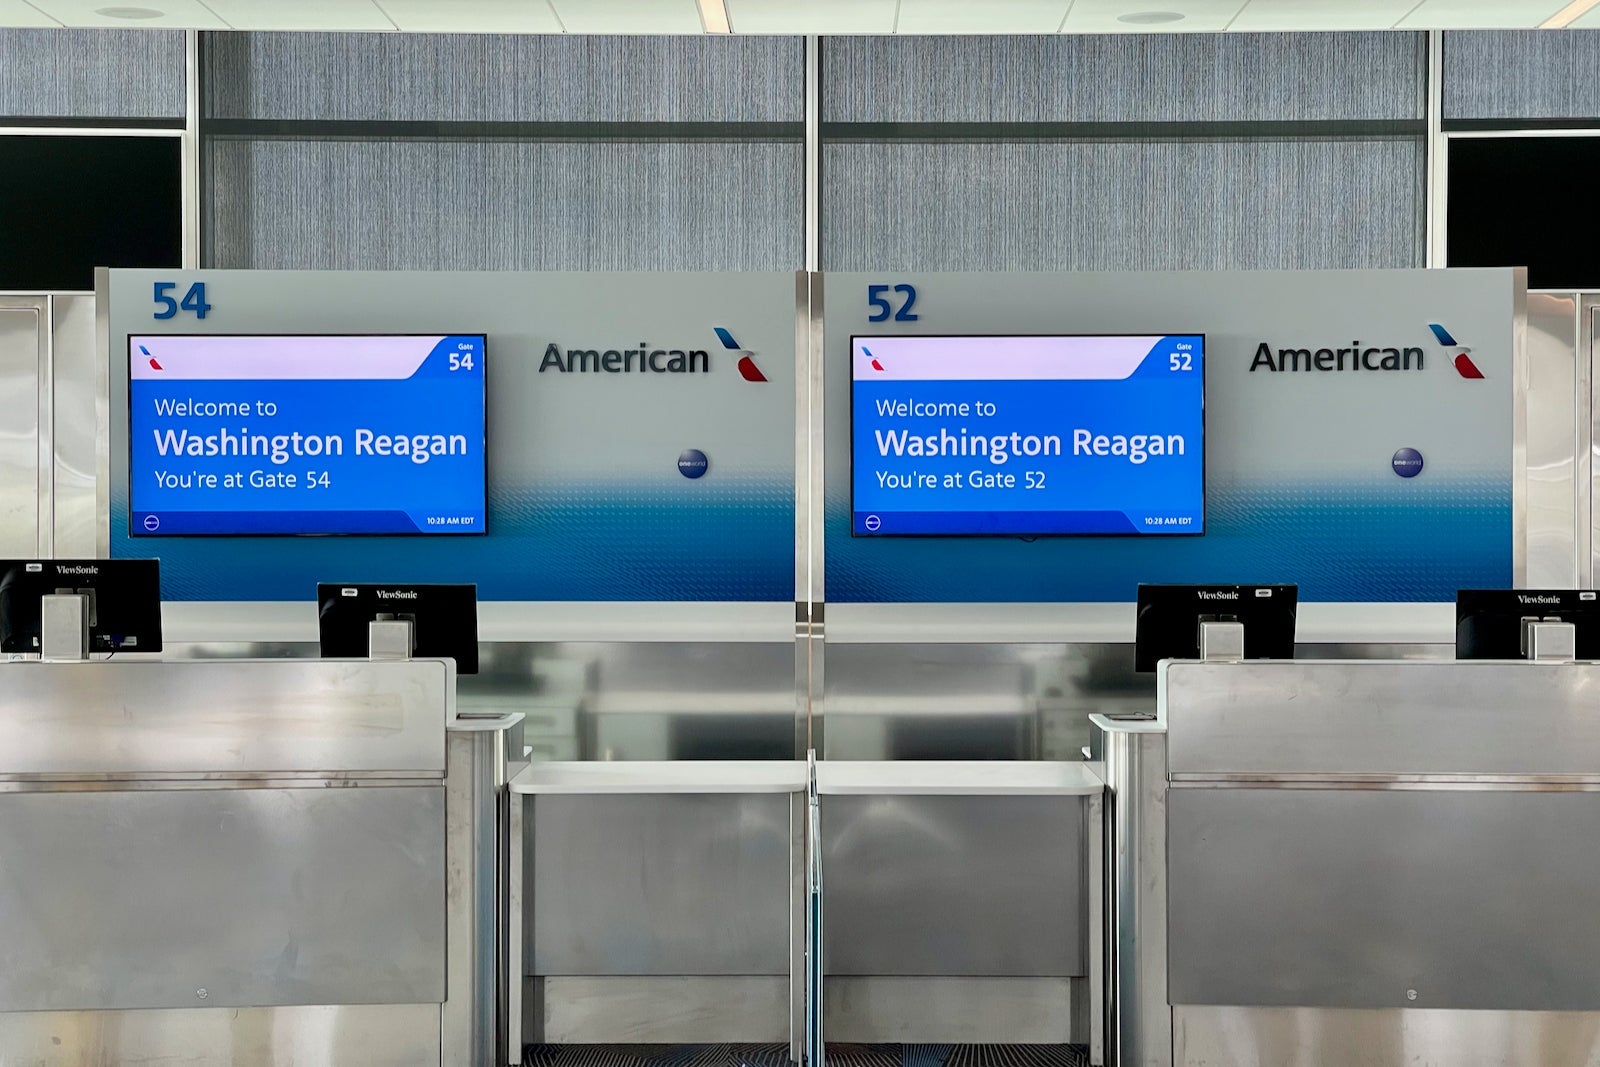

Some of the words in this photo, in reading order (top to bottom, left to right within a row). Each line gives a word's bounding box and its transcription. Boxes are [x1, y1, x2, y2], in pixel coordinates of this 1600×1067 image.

[153, 281, 211, 320] 54
[867, 283, 919, 322] 52
[458, 342, 474, 351] Gate
[1176, 342, 1192, 351] Gate
[448, 353, 474, 371] 54
[539, 342, 709, 373] American
[1169, 353, 1193, 371] 52
[1250, 340, 1424, 372] American
[154, 398, 250, 417] Welcome
[256, 400, 277, 417] to
[875, 398, 970, 417] Welcome
[975, 400, 997, 417] to
[153, 428, 343, 464] Washington
[355, 428, 467, 464] Reagan
[875, 428, 1061, 464] Washington
[1073, 428, 1185, 464] Reagan
[154, 471, 218, 489] You're
[223, 473, 244, 489] at
[250, 470, 297, 489] Gate
[306, 471, 331, 489] 54
[875, 471, 937, 489] You're
[943, 473, 963, 489] at
[968, 470, 1016, 489] Gate
[1025, 471, 1046, 489] 52
[427, 517, 446, 525] 10:28
[447, 517, 460, 525] AM
[460, 517, 474, 525] EDT
[1145, 517, 1163, 525] 10:28
[1164, 517, 1178, 525] AM
[1178, 517, 1192, 525] EDT
[56, 565, 99, 574] ViewSonic
[376, 590, 418, 599] ViewSonic
[1197, 591, 1240, 600] ViewSonic
[1518, 595, 1561, 604] ViewSonic
